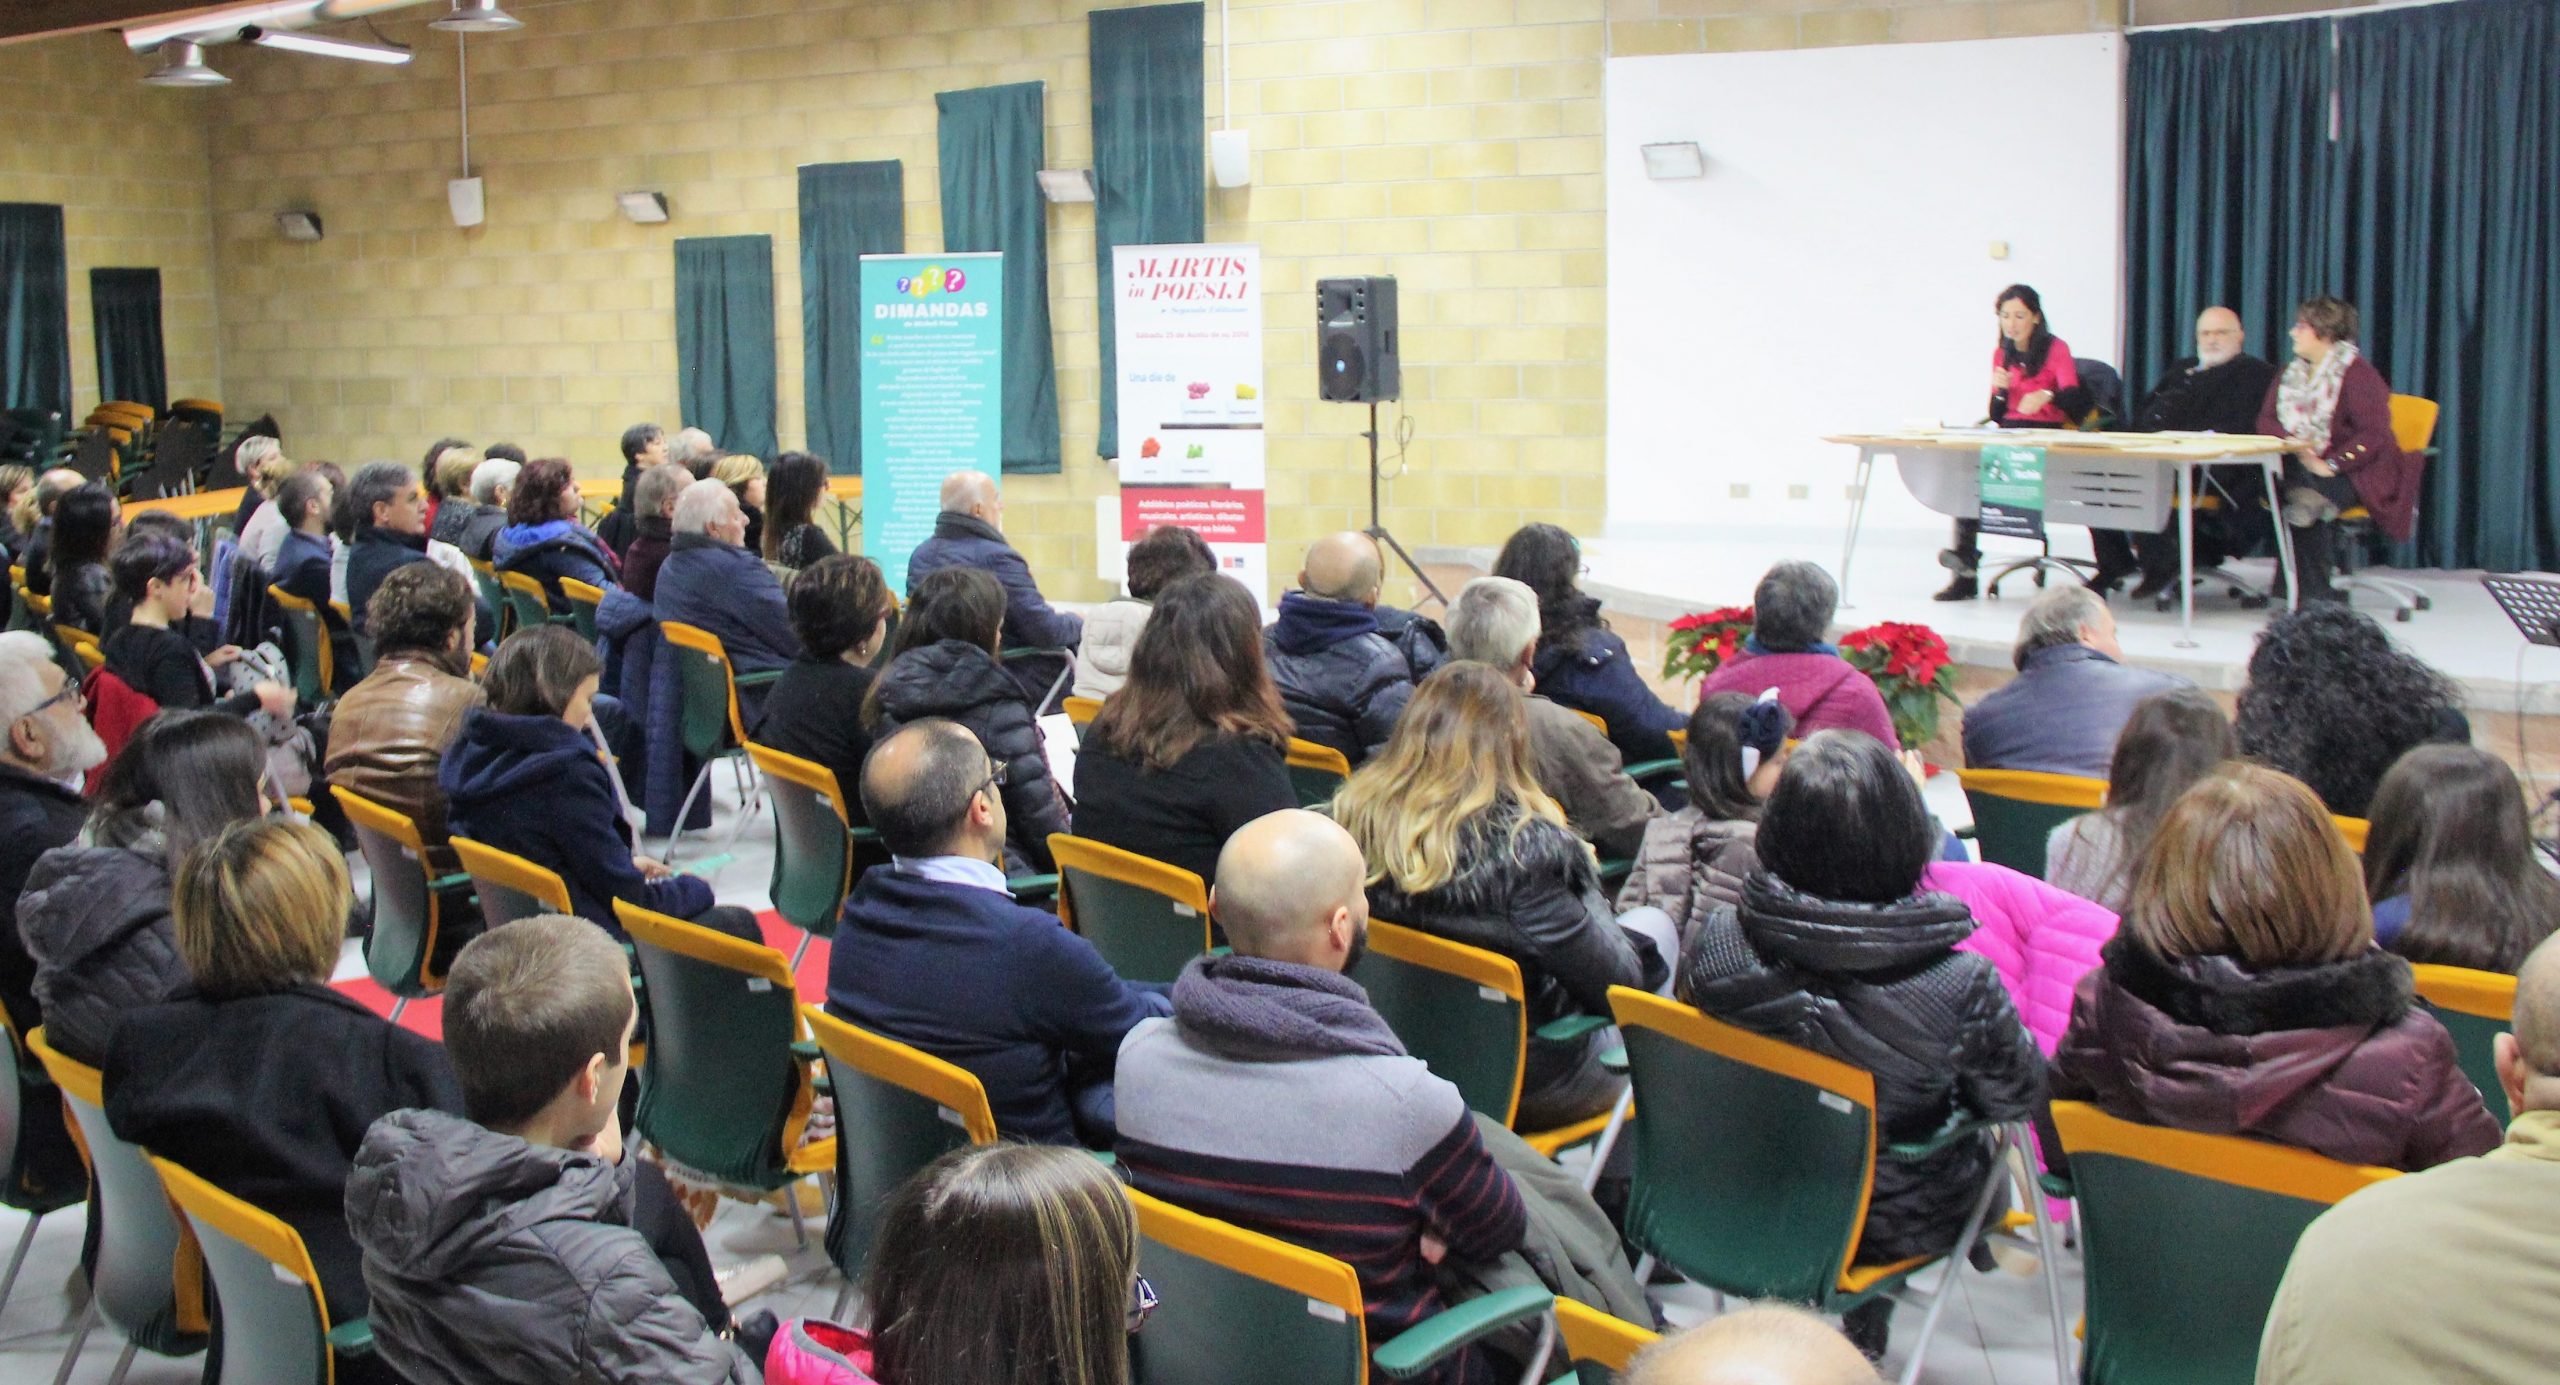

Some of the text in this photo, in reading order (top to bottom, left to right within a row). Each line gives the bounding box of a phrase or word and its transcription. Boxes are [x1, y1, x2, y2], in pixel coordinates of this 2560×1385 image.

[1128, 256, 1247, 279] MARTIS
[1128, 281, 1248, 301] in POESIA
[874, 302, 988, 319] DIMANDAS
